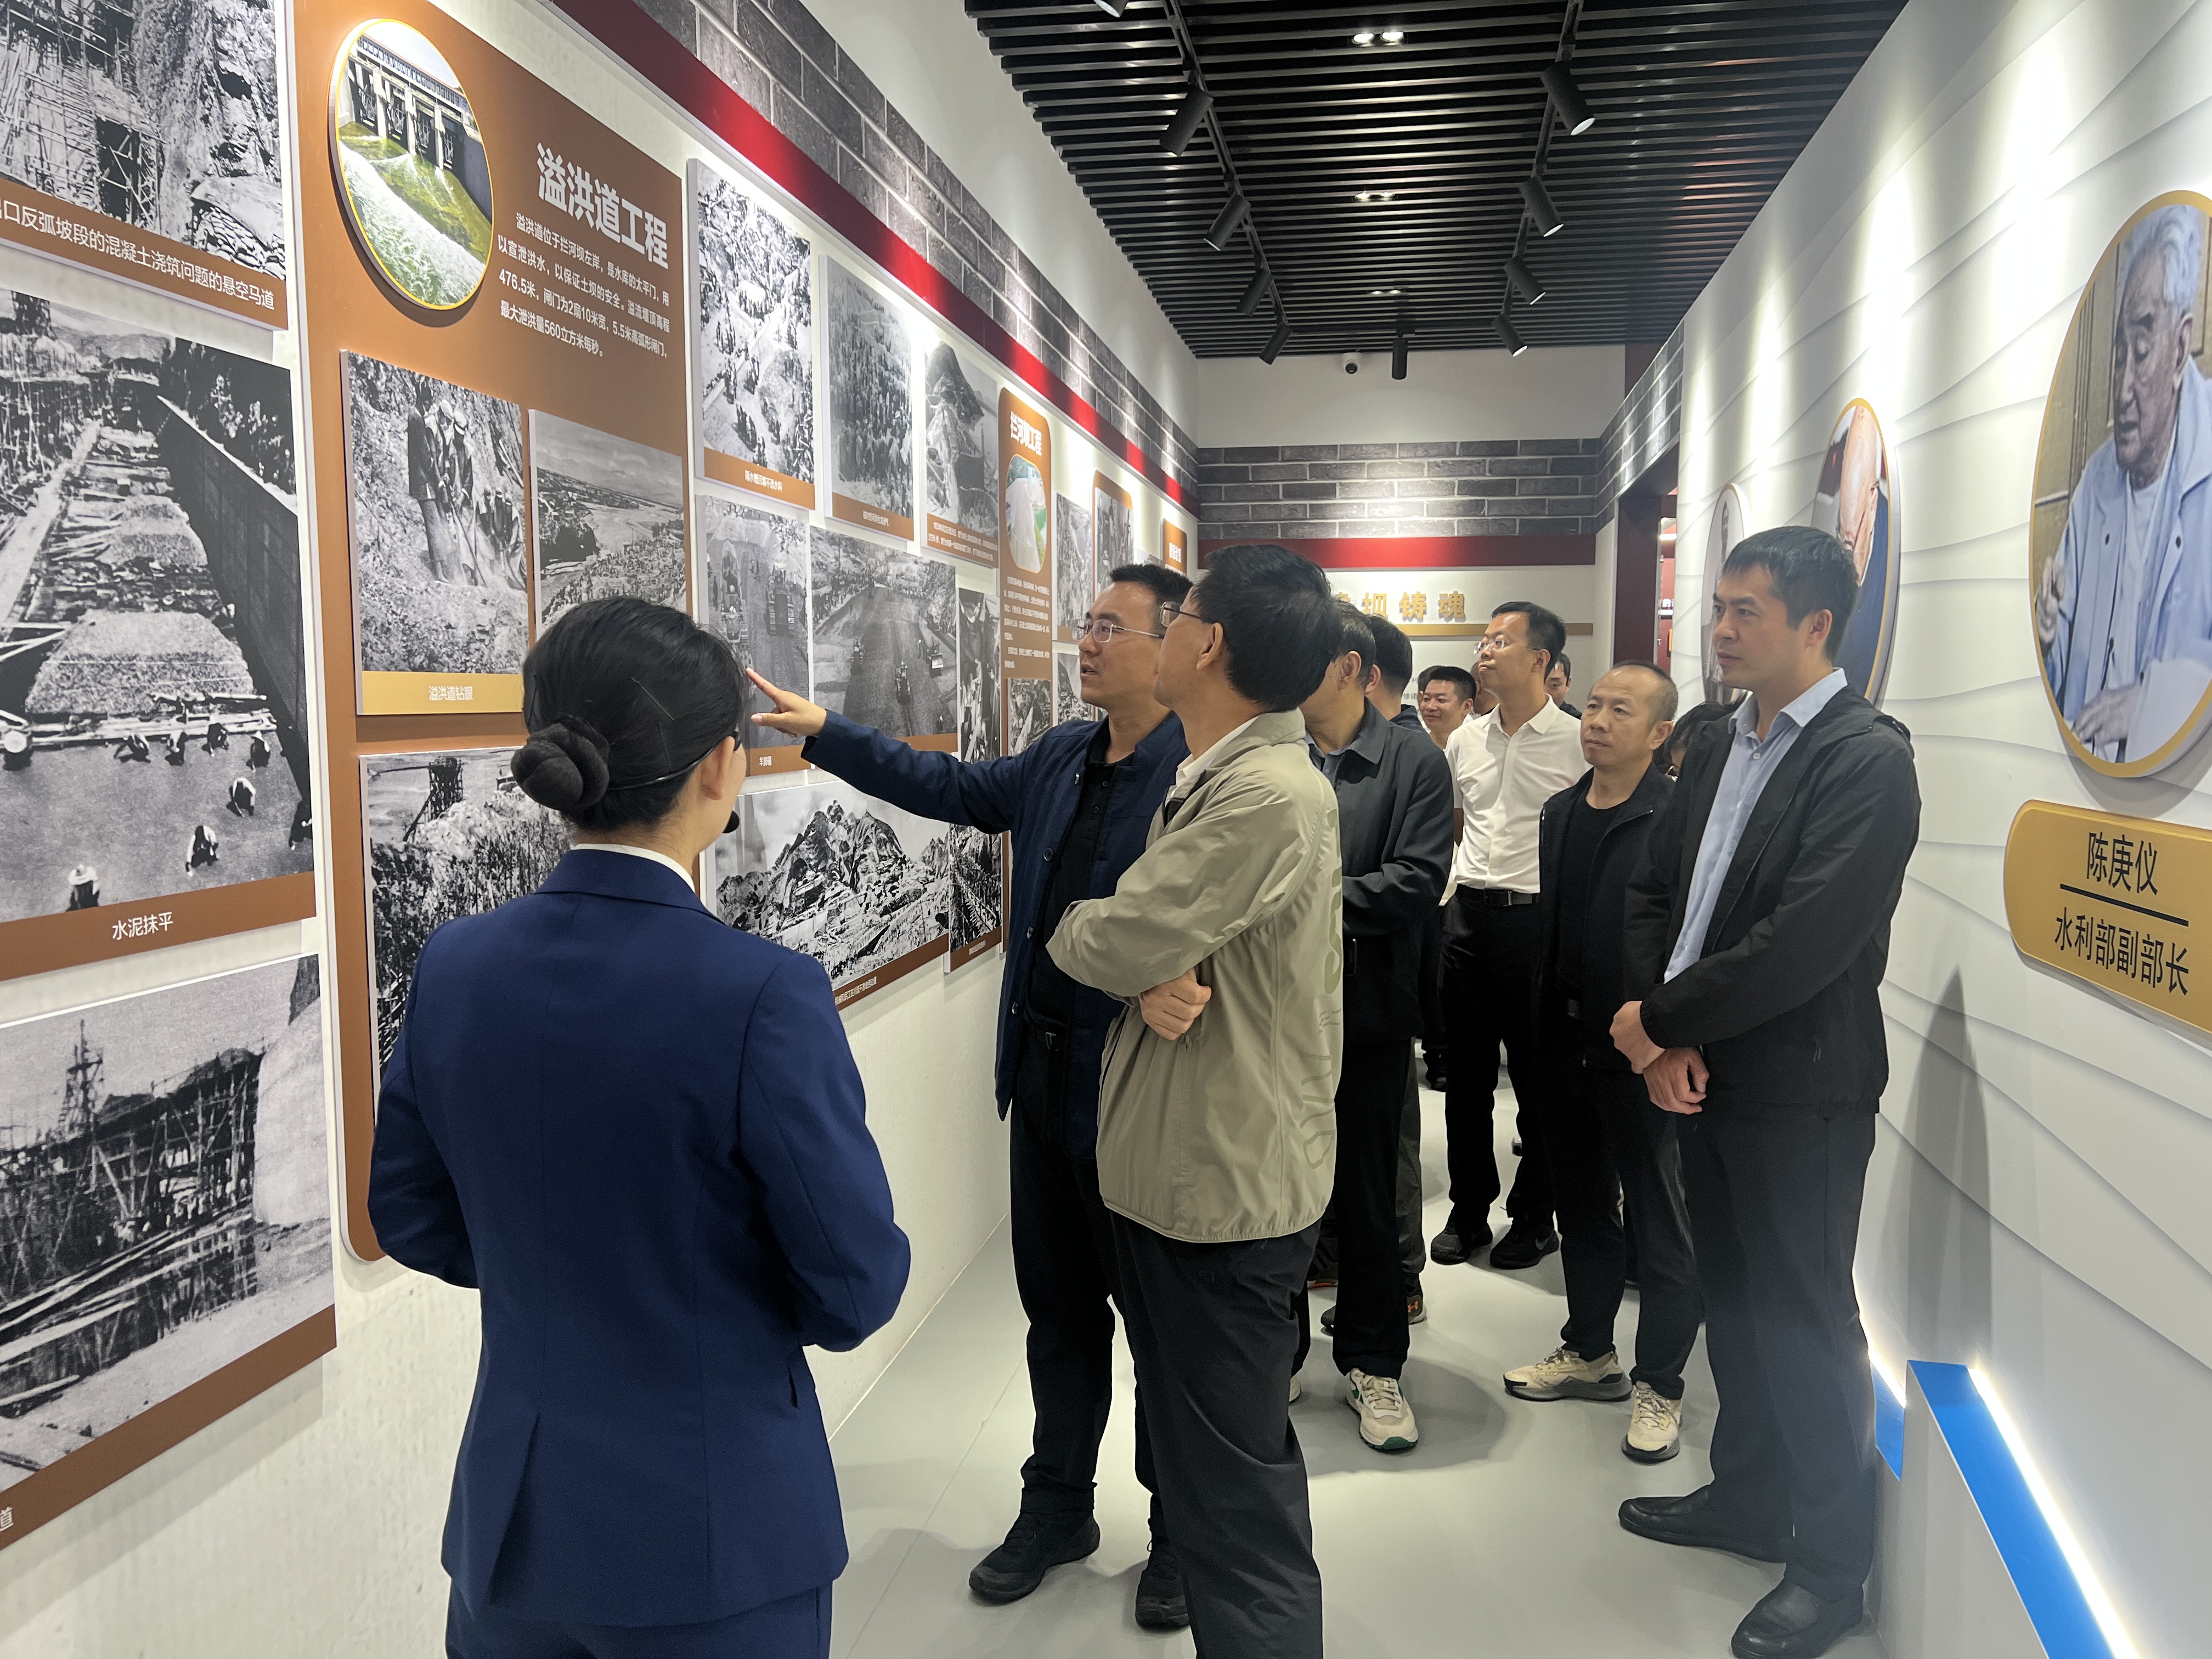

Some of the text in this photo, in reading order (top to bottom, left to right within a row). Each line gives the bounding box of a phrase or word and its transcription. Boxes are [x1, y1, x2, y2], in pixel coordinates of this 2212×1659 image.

[537, 142, 668, 269] 溢洪道工程
[0, 199, 275, 310] 口反弧坡段的混凝土浇筑问题的悬空马道
[1335, 591, 1465, 619] 坝铸魂
[428, 685, 473, 701] 溢洪道钻眼
[2086, 831, 2158, 895] 陈庚仪
[112, 912, 173, 940] 水泥抹平
[2055, 907, 2190, 996] 水利部副部长
